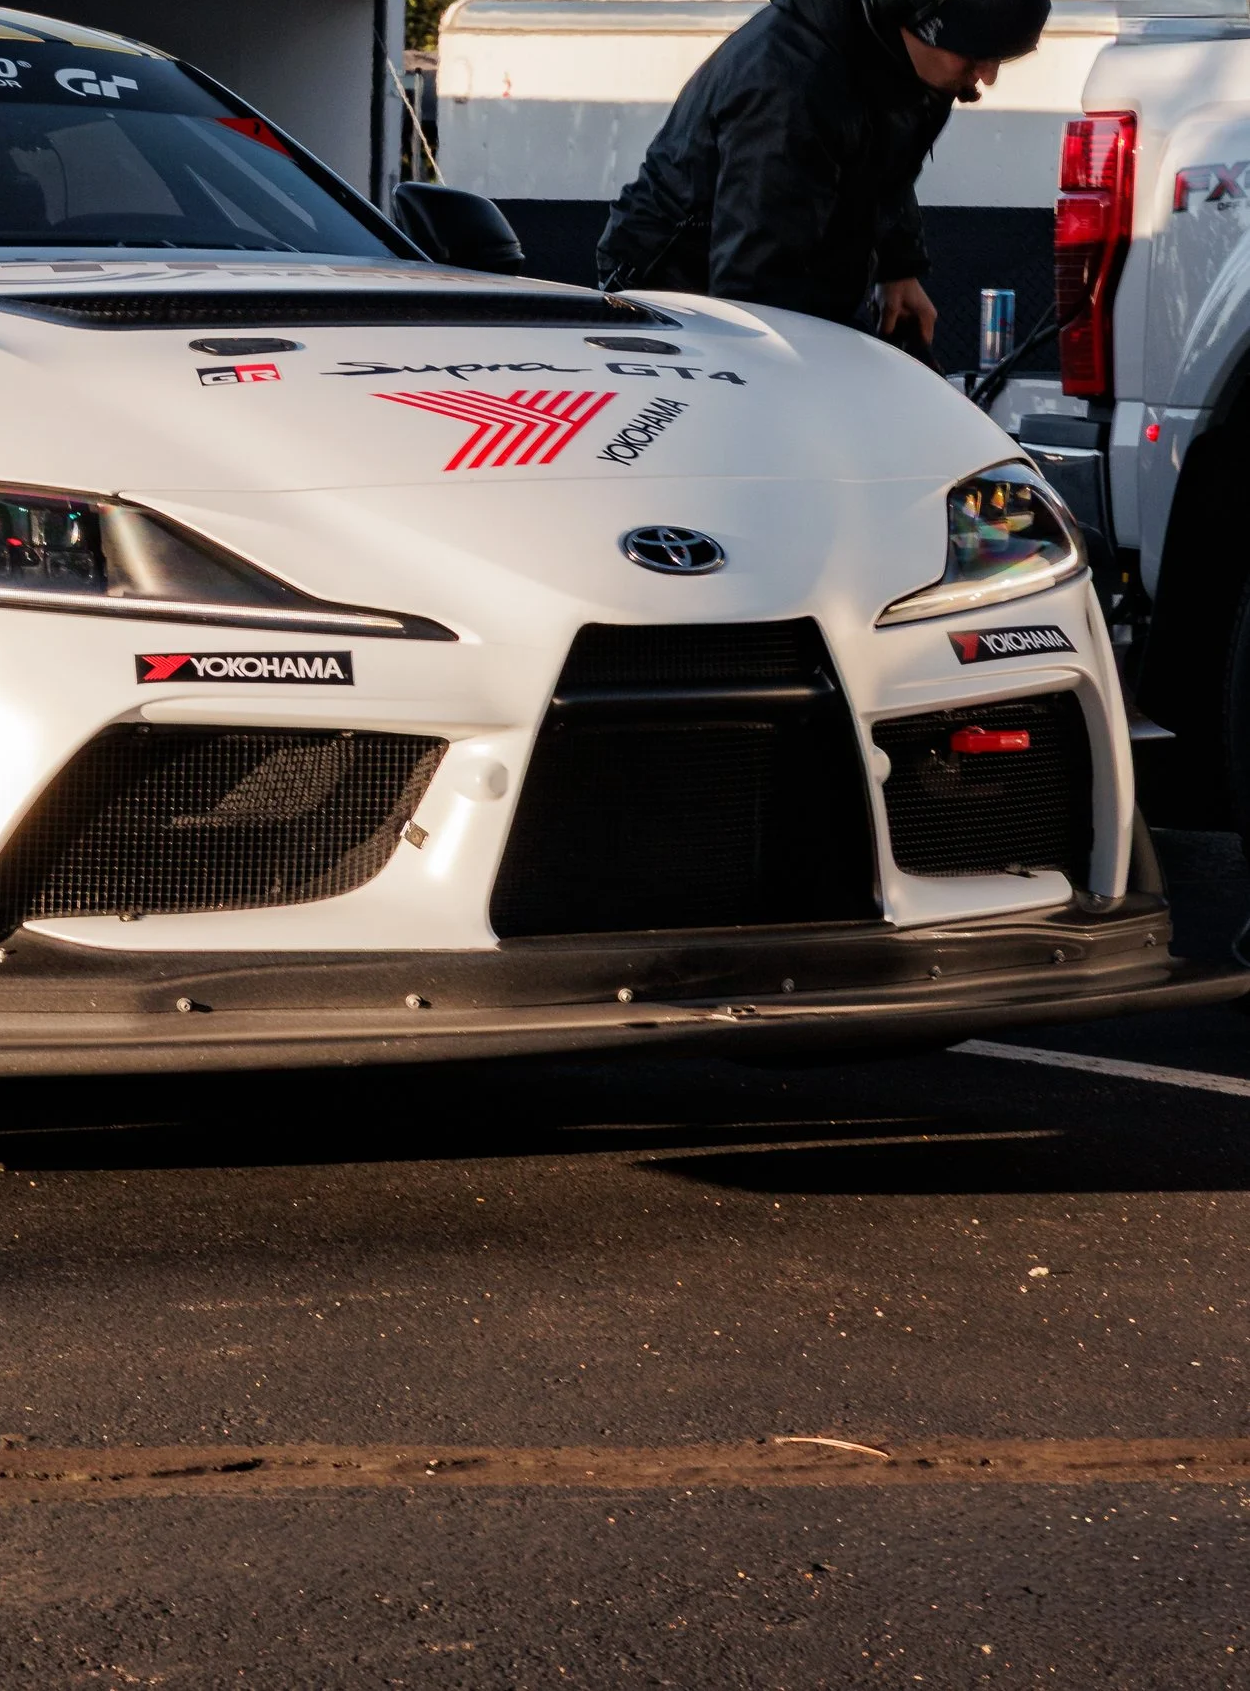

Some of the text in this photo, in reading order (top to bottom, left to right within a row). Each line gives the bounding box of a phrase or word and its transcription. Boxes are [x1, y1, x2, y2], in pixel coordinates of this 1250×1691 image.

[1172, 159, 1250, 214] FX
[198, 366, 281, 386] GR
[319, 361, 747, 386] Supra GT4
[596, 397, 690, 467] YOKOHAMA
[979, 630, 1070, 654] YOKOHAMA
[190, 657, 345, 679] YOKOHAMA
